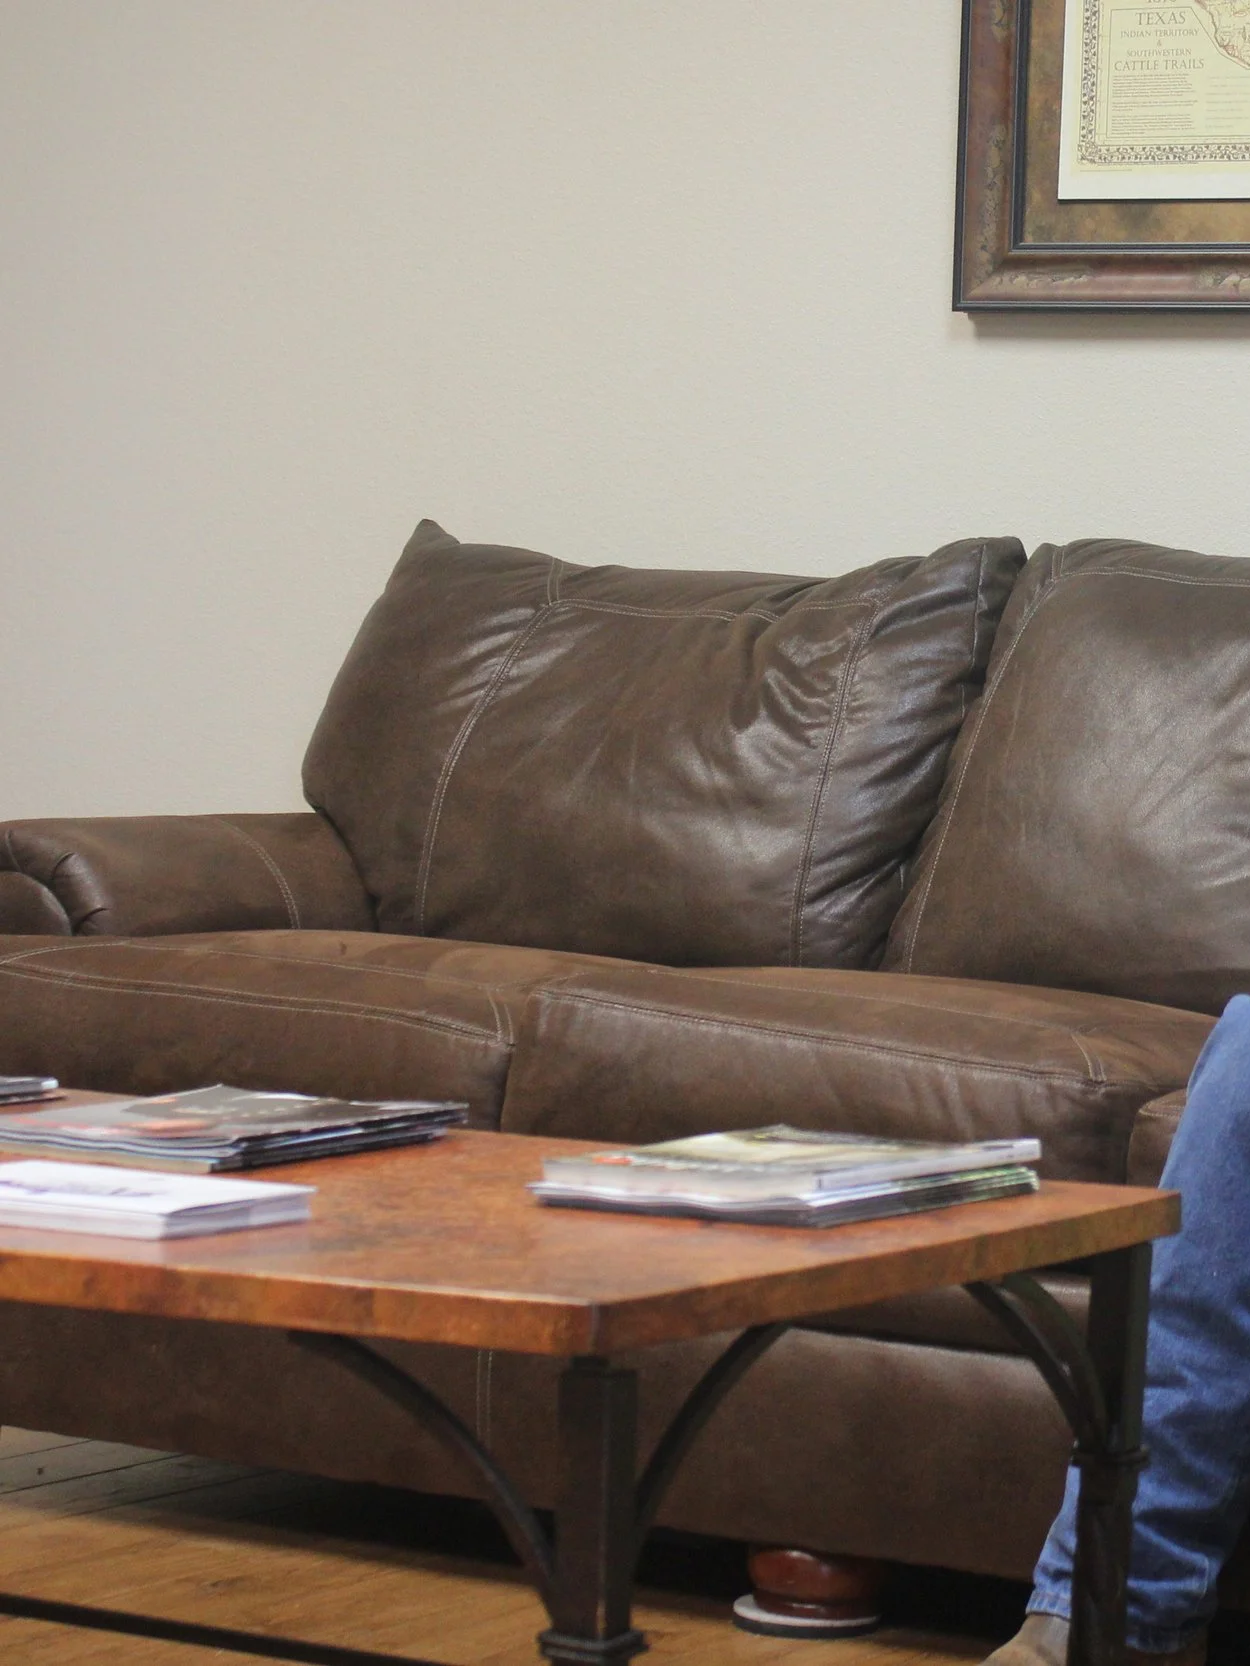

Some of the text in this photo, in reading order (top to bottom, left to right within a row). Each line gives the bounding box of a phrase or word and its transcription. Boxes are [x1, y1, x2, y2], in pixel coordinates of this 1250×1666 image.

[1135, 11, 1186, 25] TEXAS
[1120, 28, 1199, 38] INDIAN TERRITORY
[1126, 48, 1192, 57] SOUTHWESTERN
[1114, 59, 1204, 71] CATTLE TRAILS
